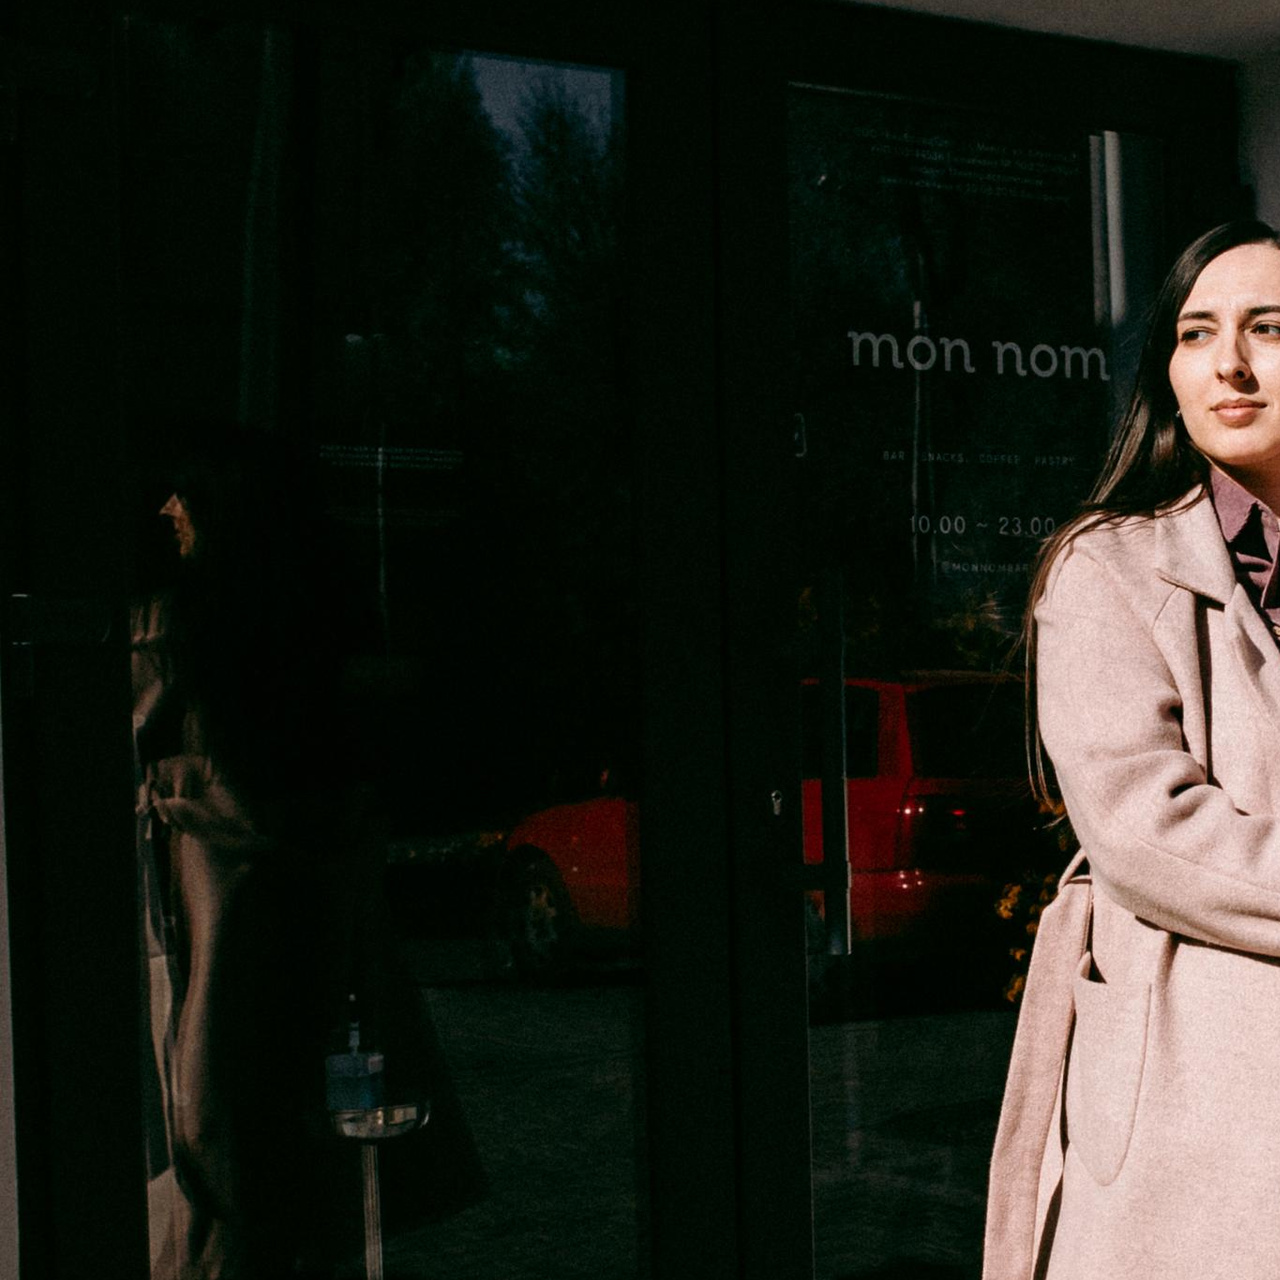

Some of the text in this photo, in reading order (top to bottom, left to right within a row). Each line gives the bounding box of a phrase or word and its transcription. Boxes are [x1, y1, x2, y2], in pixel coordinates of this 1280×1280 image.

[847, 328, 1111, 382] mon nom
[882, 450, 906, 461] BAR
[978, 453, 1021, 465] COFFEE
[909, 514, 966, 535] 10.00
[998, 516, 1056, 537] 23.00
